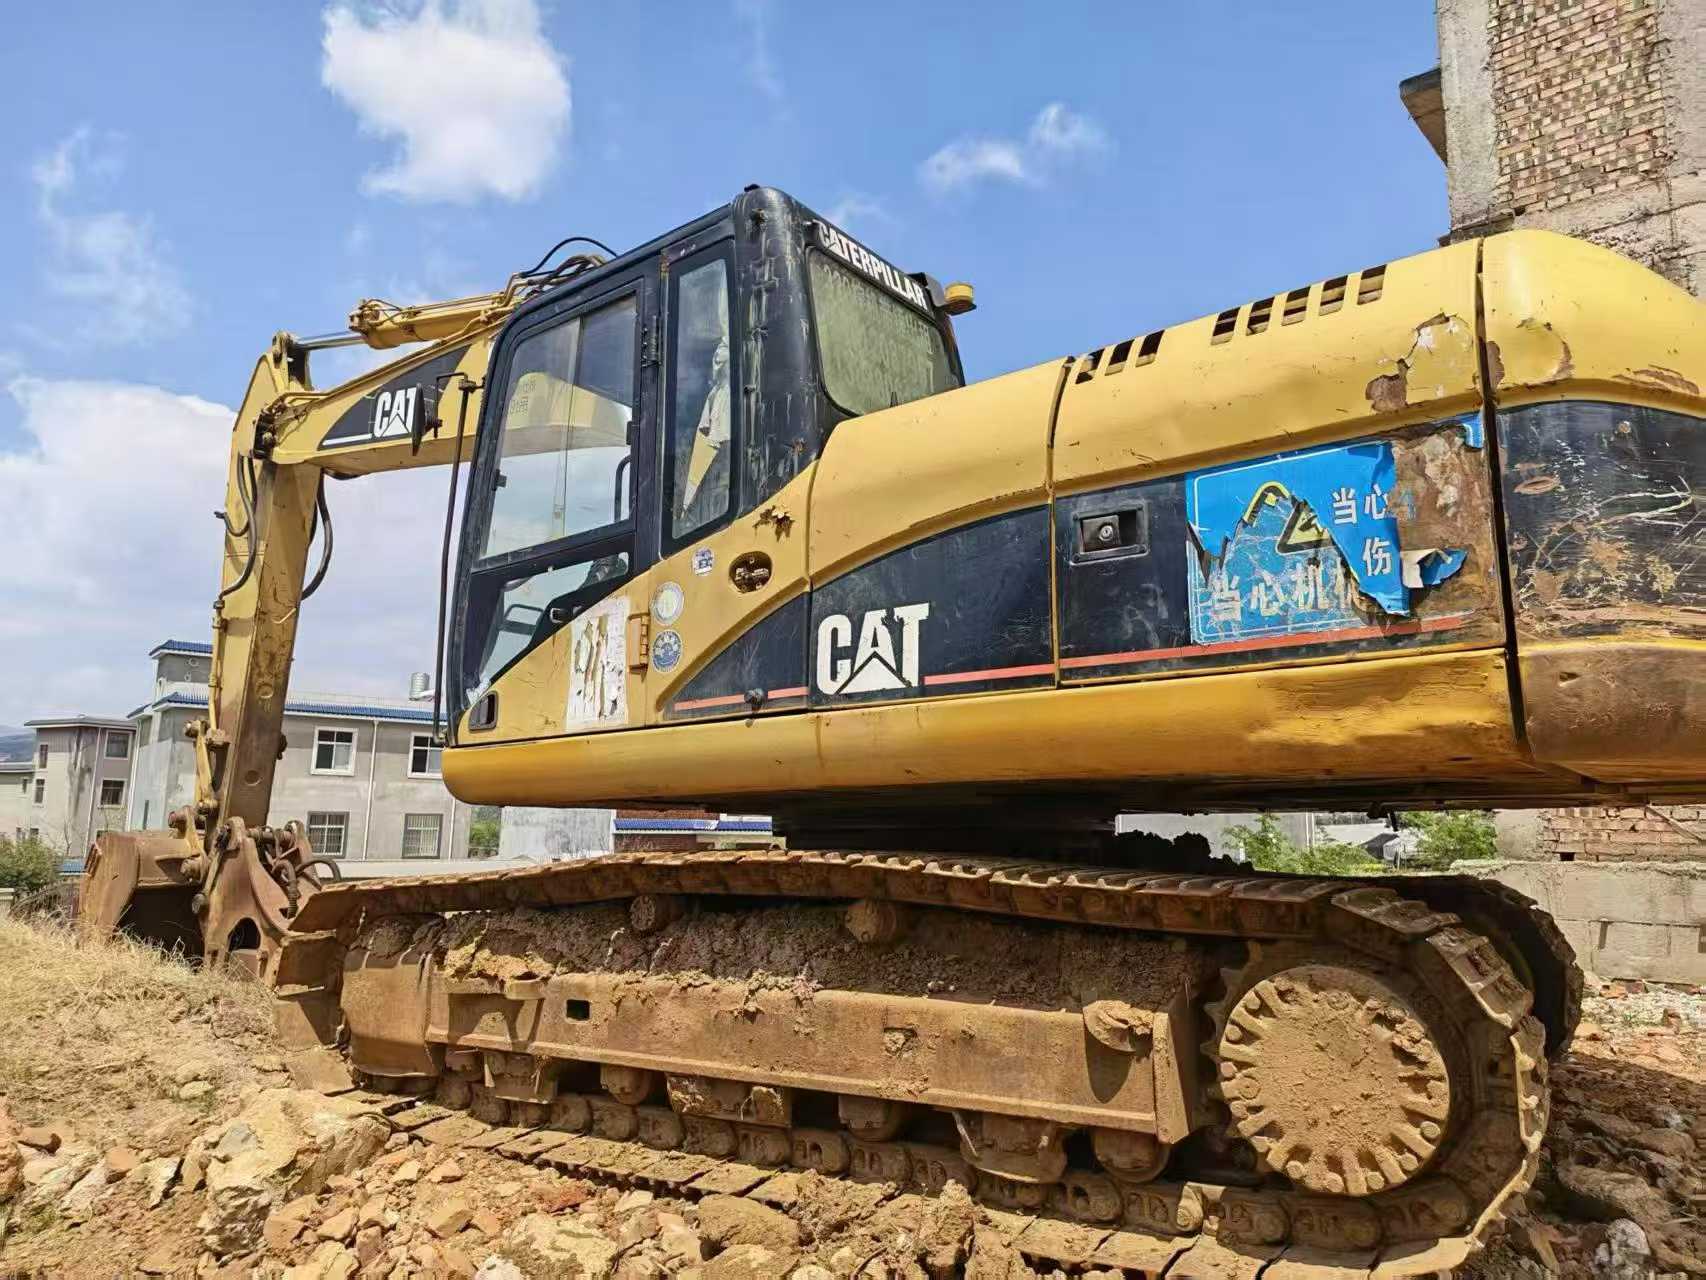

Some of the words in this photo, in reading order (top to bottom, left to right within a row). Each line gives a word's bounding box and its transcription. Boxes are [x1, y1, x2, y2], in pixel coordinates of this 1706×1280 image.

[818, 221, 929, 311] CATERPILLAR
[373, 386, 418, 438] CAT
[816, 602, 930, 696] CAT
